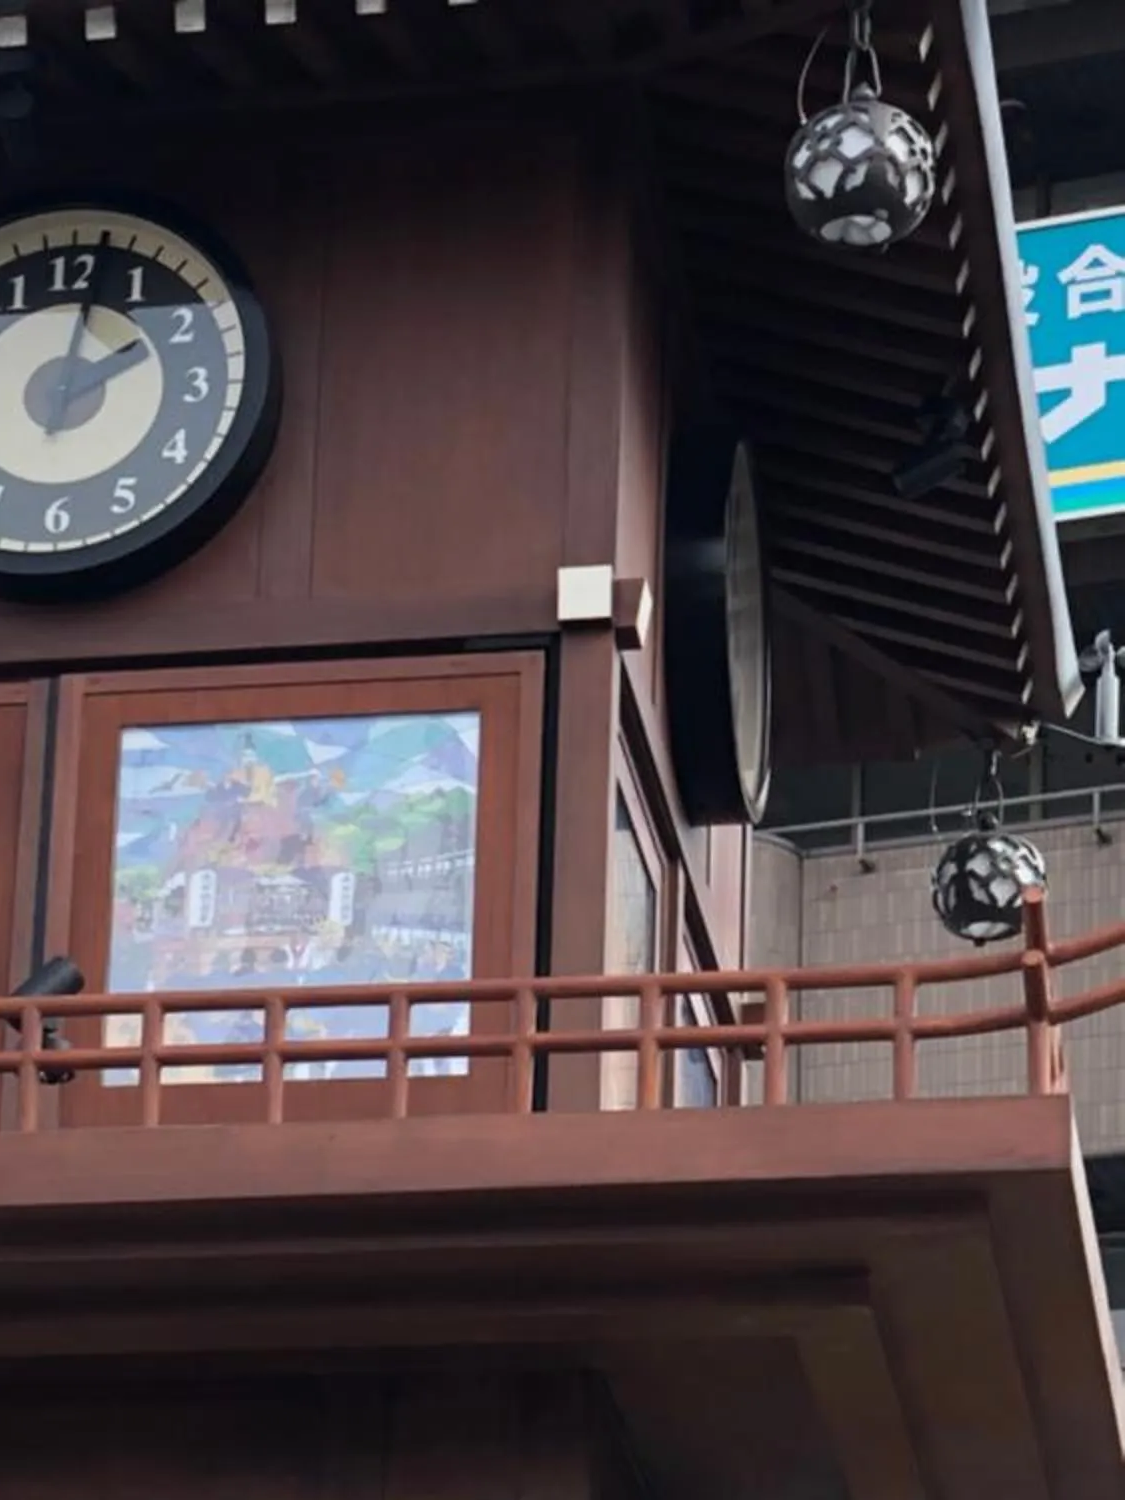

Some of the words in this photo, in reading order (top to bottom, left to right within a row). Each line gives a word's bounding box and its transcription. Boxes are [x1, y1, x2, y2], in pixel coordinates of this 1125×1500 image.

[48, 254, 95, 292] 12
[127, 267, 146, 302] 1
[169, 307, 195, 344] 2
[183, 366, 210, 403] 3
[162, 428, 188, 464] 4
[109, 476, 138, 514] 5
[43, 495, 71, 534] 6
